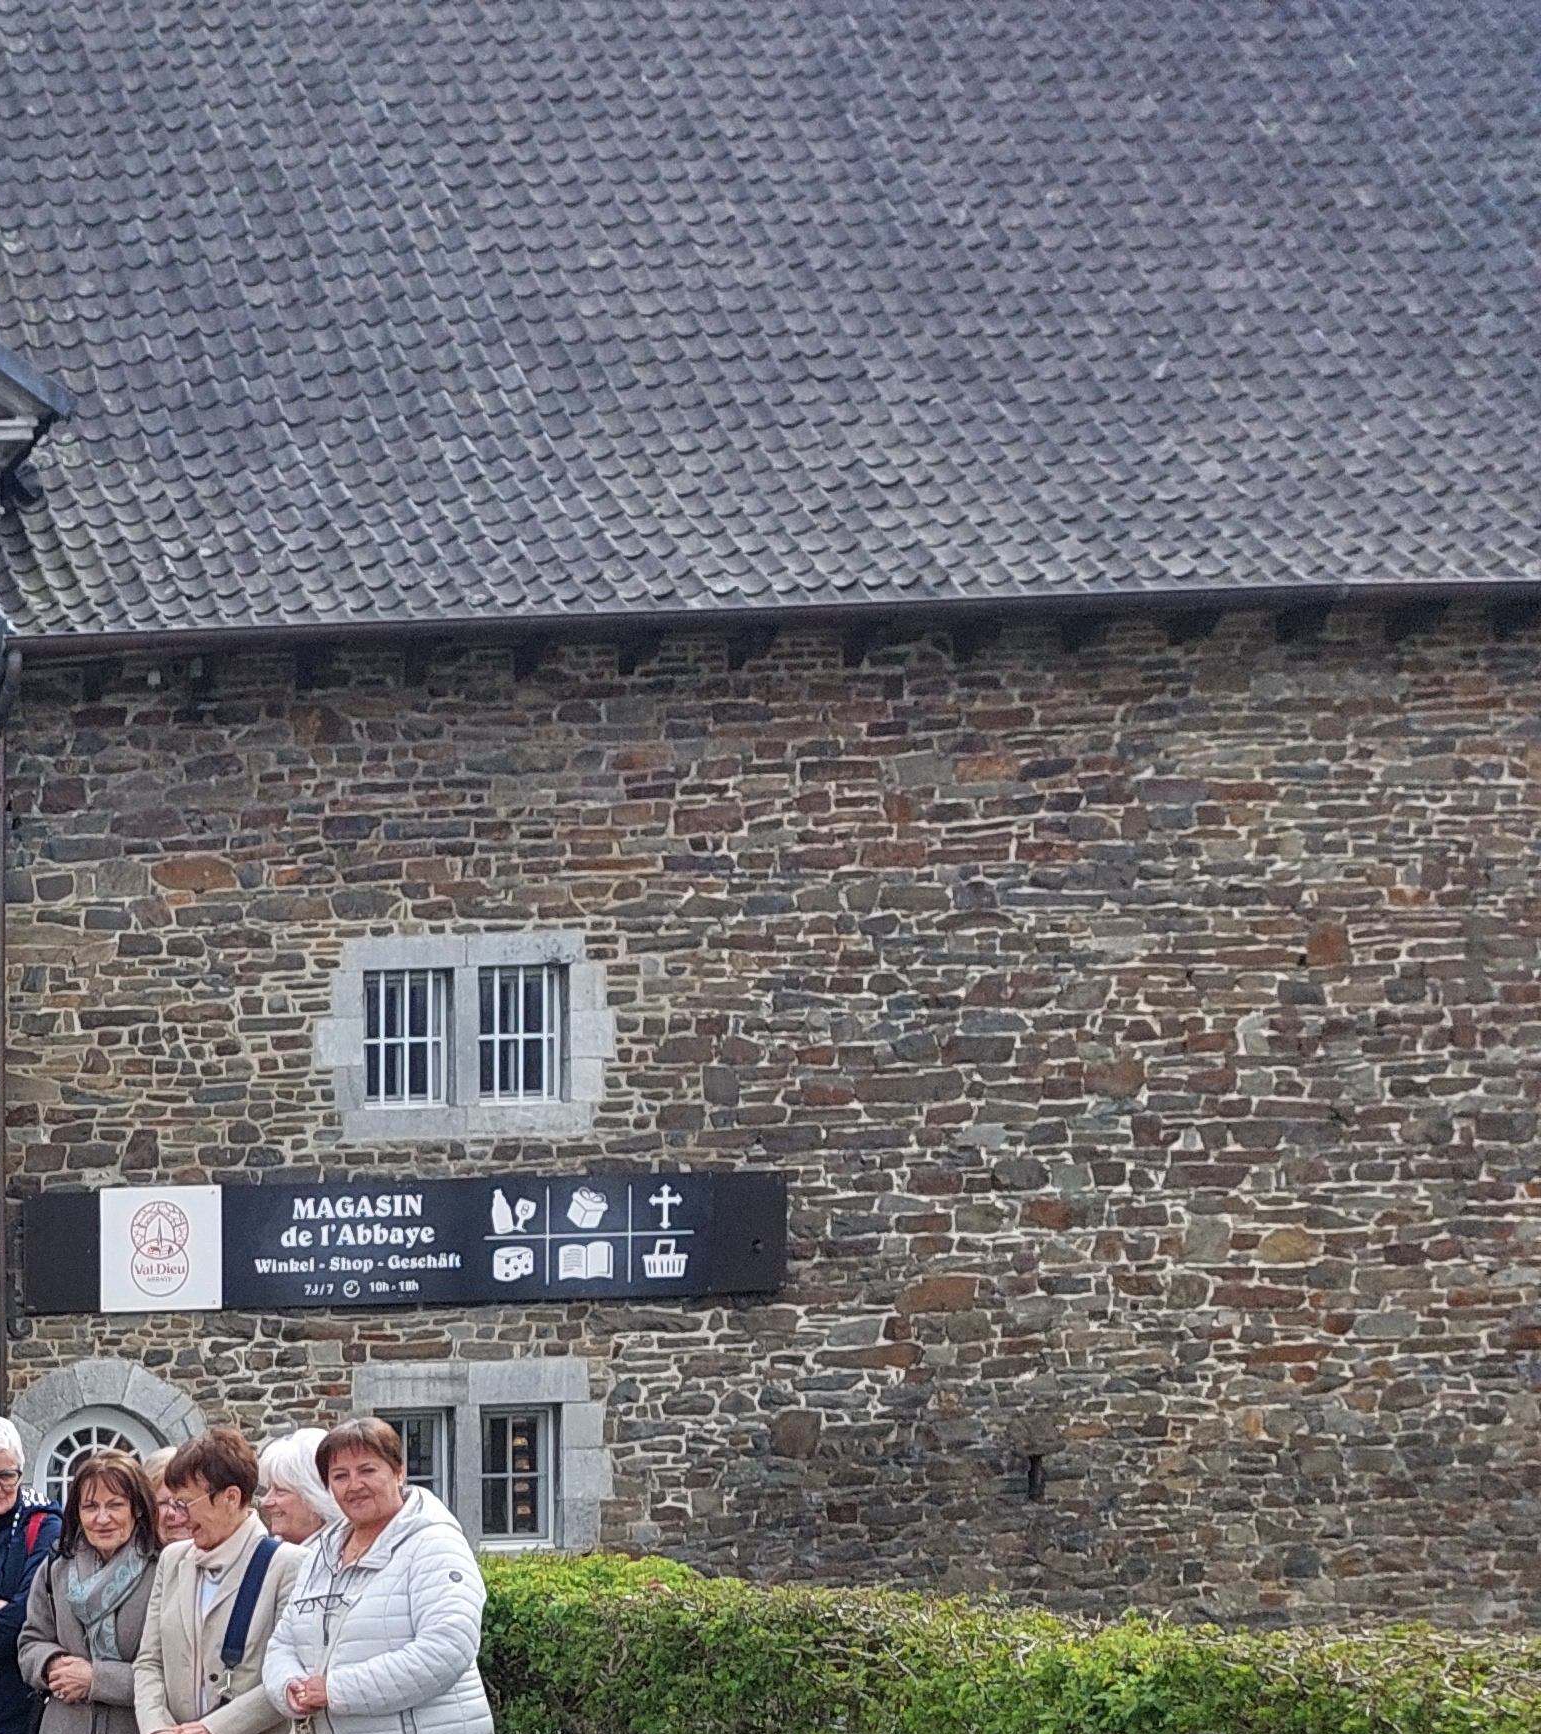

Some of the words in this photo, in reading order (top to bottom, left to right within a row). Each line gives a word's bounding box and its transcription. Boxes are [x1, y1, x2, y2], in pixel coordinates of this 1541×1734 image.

[292, 1194, 423, 1220] MAGASIN
[280, 1226, 314, 1248] de
[320, 1223, 436, 1248] l'Abbaye
[254, 1257, 315, 1274] Winkel
[329, 1255, 374, 1274] Shop
[387, 1252, 462, 1270] Geschäft
